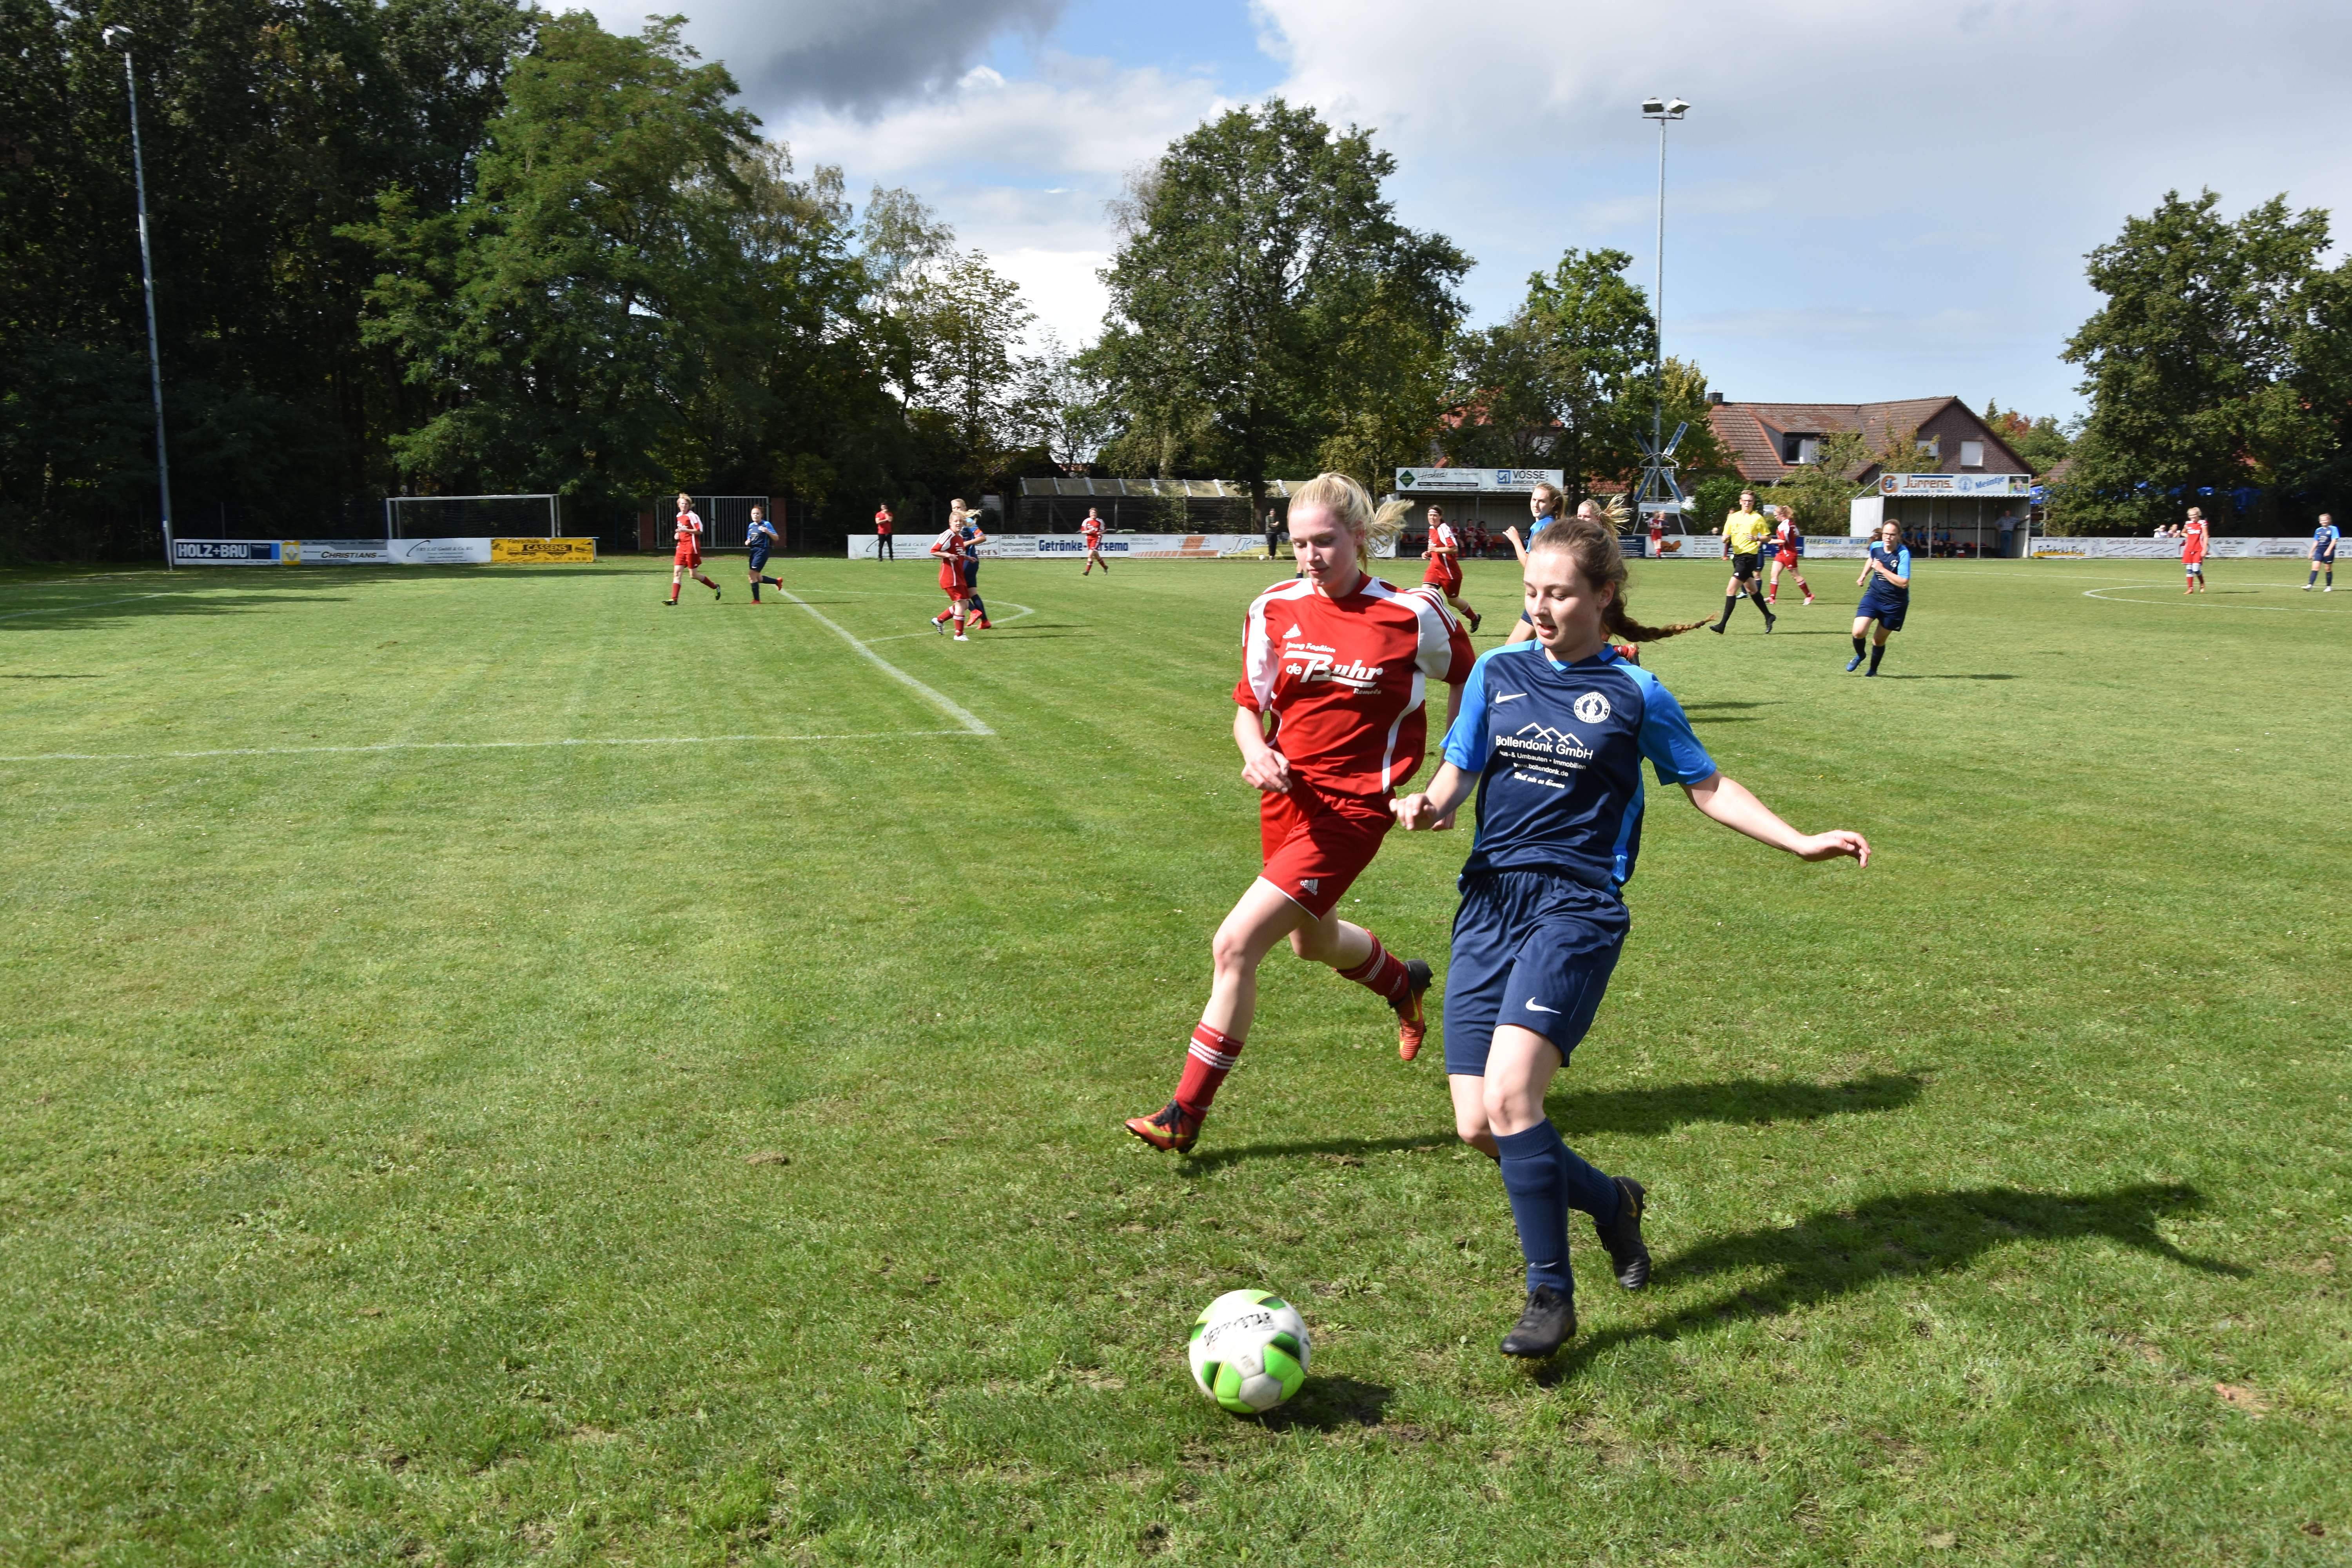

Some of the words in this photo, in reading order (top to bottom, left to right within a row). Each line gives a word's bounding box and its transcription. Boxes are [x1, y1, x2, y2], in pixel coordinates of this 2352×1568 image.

[1512, 470, 1545, 479] VOSSE
[178, 544, 248, 558] HOLZ+BAU
[1305, 642, 1336, 653] Fashion
[1286, 663, 1302, 675] de
[1290, 650, 1383, 684] Buhr
[1495, 735, 1553, 753] Bollendonk
[1555, 744, 1593, 760] GmbH
[1517, 753, 1548, 763] Umbauten
[1553, 759, 1586, 770] Immobilien
[1513, 762, 1569, 777] www.bollendonk.de
[1299, 880, 1318, 896] adidas
